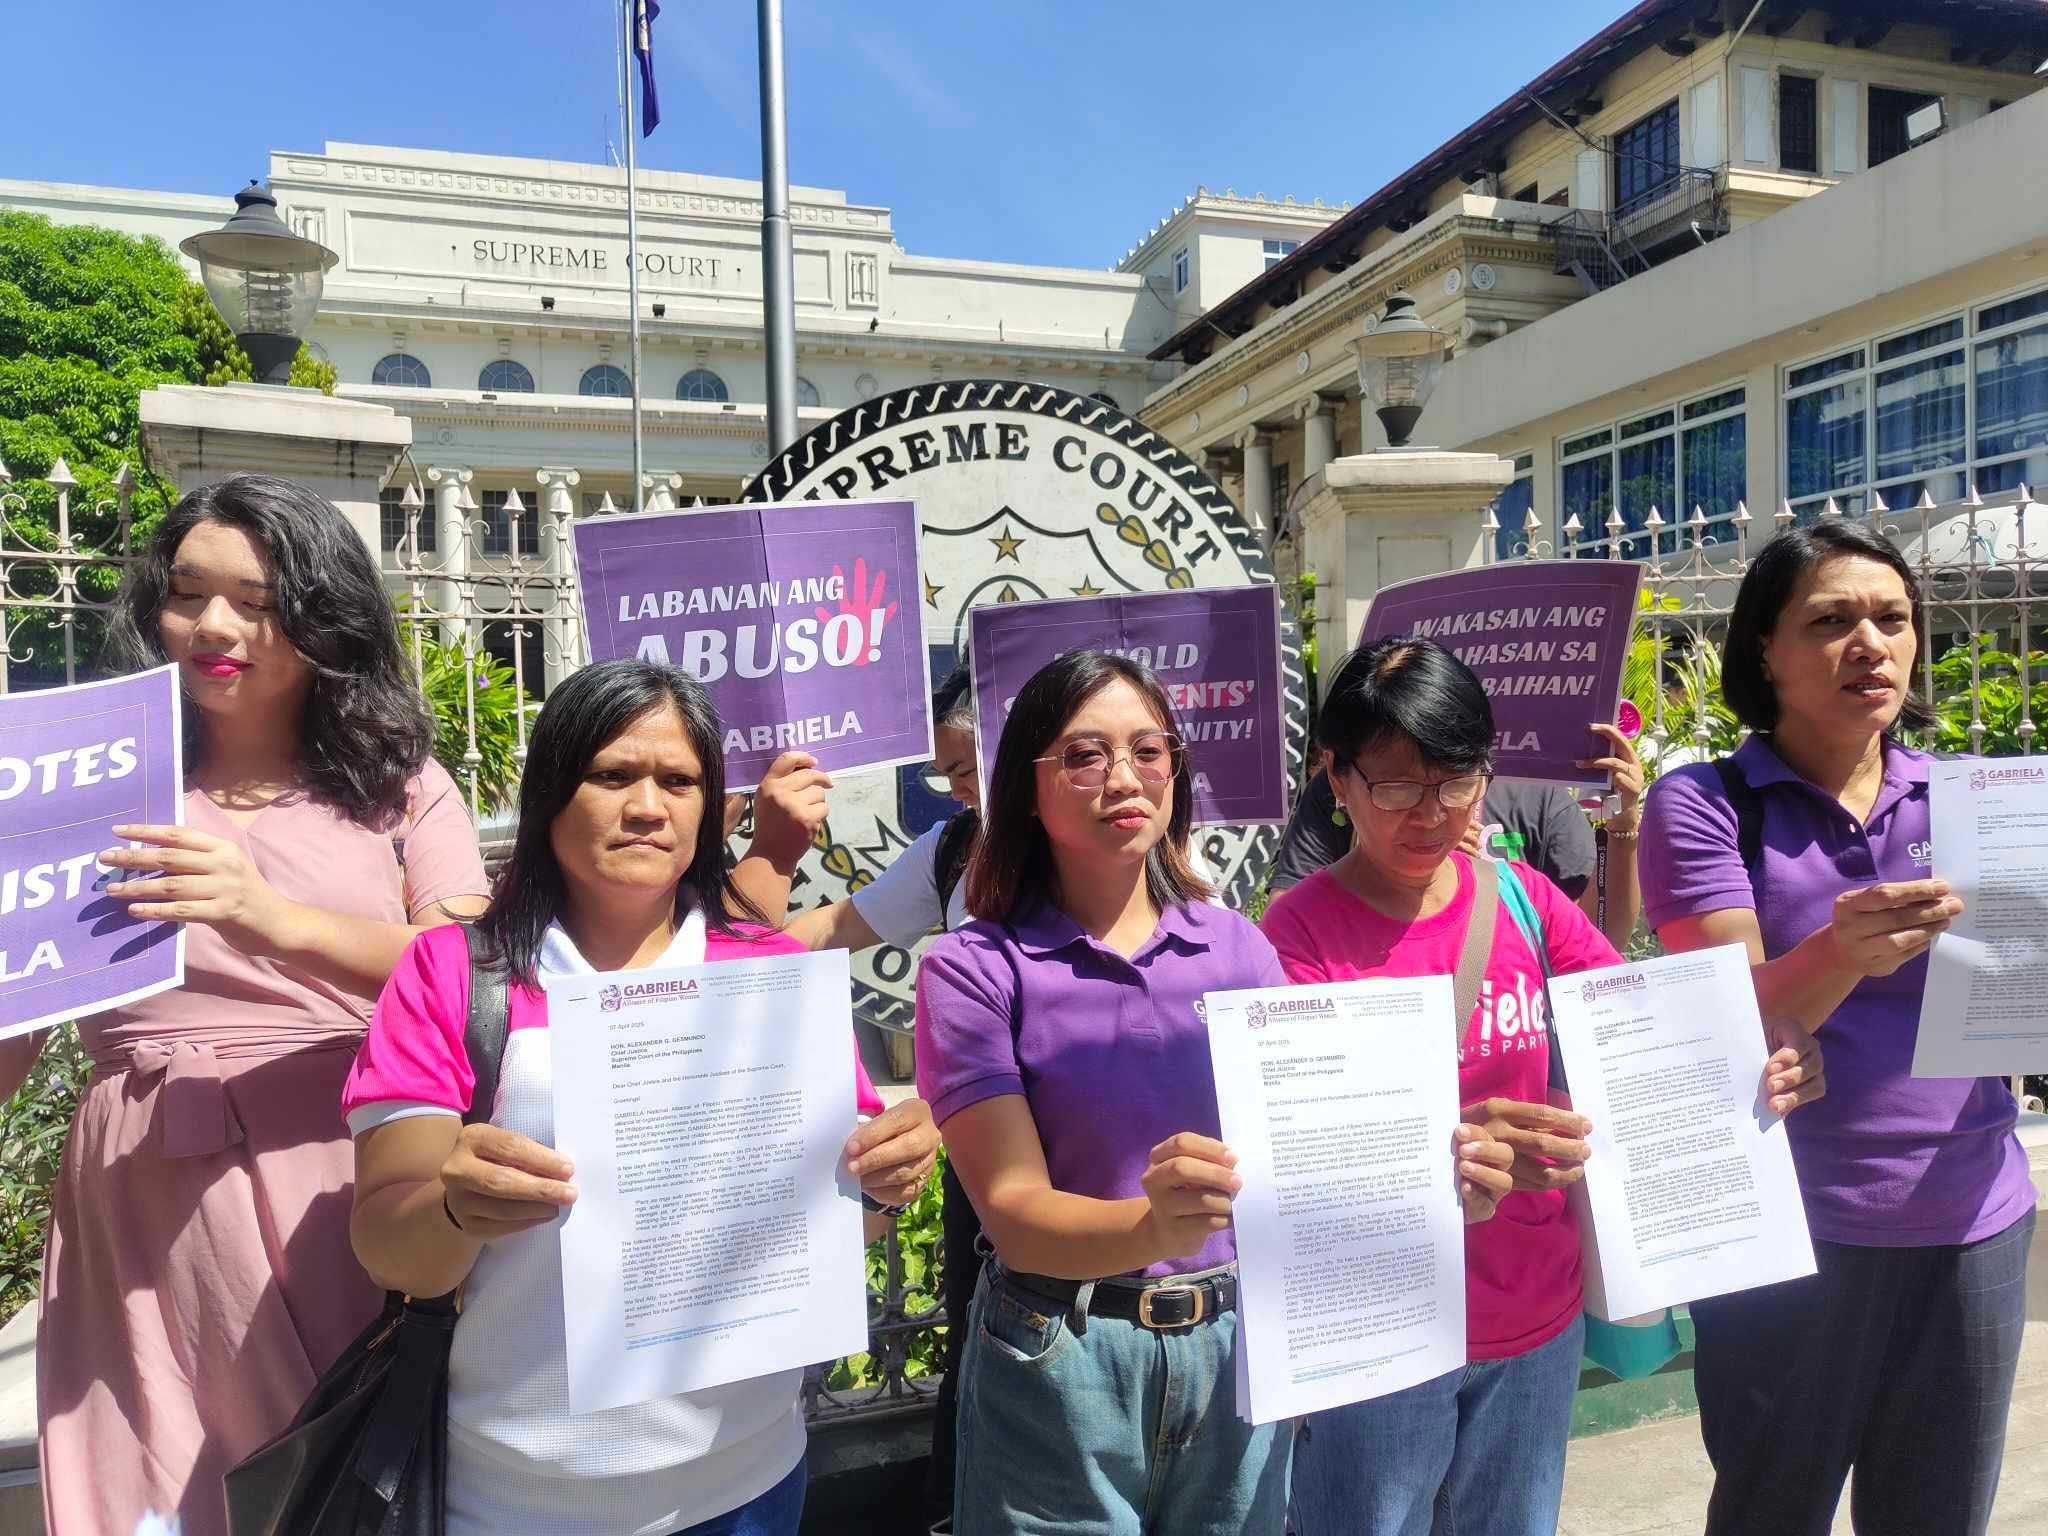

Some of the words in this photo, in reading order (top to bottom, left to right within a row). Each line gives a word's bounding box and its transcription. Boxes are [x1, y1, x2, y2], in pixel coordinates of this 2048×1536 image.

[473, 239, 608, 270] SUPREME
[626, 252, 721, 278] COURT
[804, 422, 1030, 500] PREME
[1052, 435, 1222, 568] COURT
[618, 581, 780, 622] LABANAN
[787, 575, 844, 605] ANG
[1412, 607, 1541, 638] WAKASAN
[1543, 606, 1606, 628] ANG
[633, 608, 886, 684] ABUSO!
[1452, 641, 1555, 667] AHASAN
[1560, 641, 1597, 662] SA
[1167, 680, 1255, 711] ENTS'
[1481, 675, 1596, 697] BAIHAN!
[722, 711, 863, 754] ABRIELA
[1178, 718, 1254, 742] NITY!
[0, 736, 137, 801] OTES
[1988, 768, 2044, 778] GABRIELA
[0, 839, 146, 916] ISTS!
[623, 978, 697, 996] GABRIELA
[1595, 973, 1644, 989] GABRIELA
[1268, 997, 1334, 1013] GABRIELA
[1502, 1035, 1548, 1054] PAR
